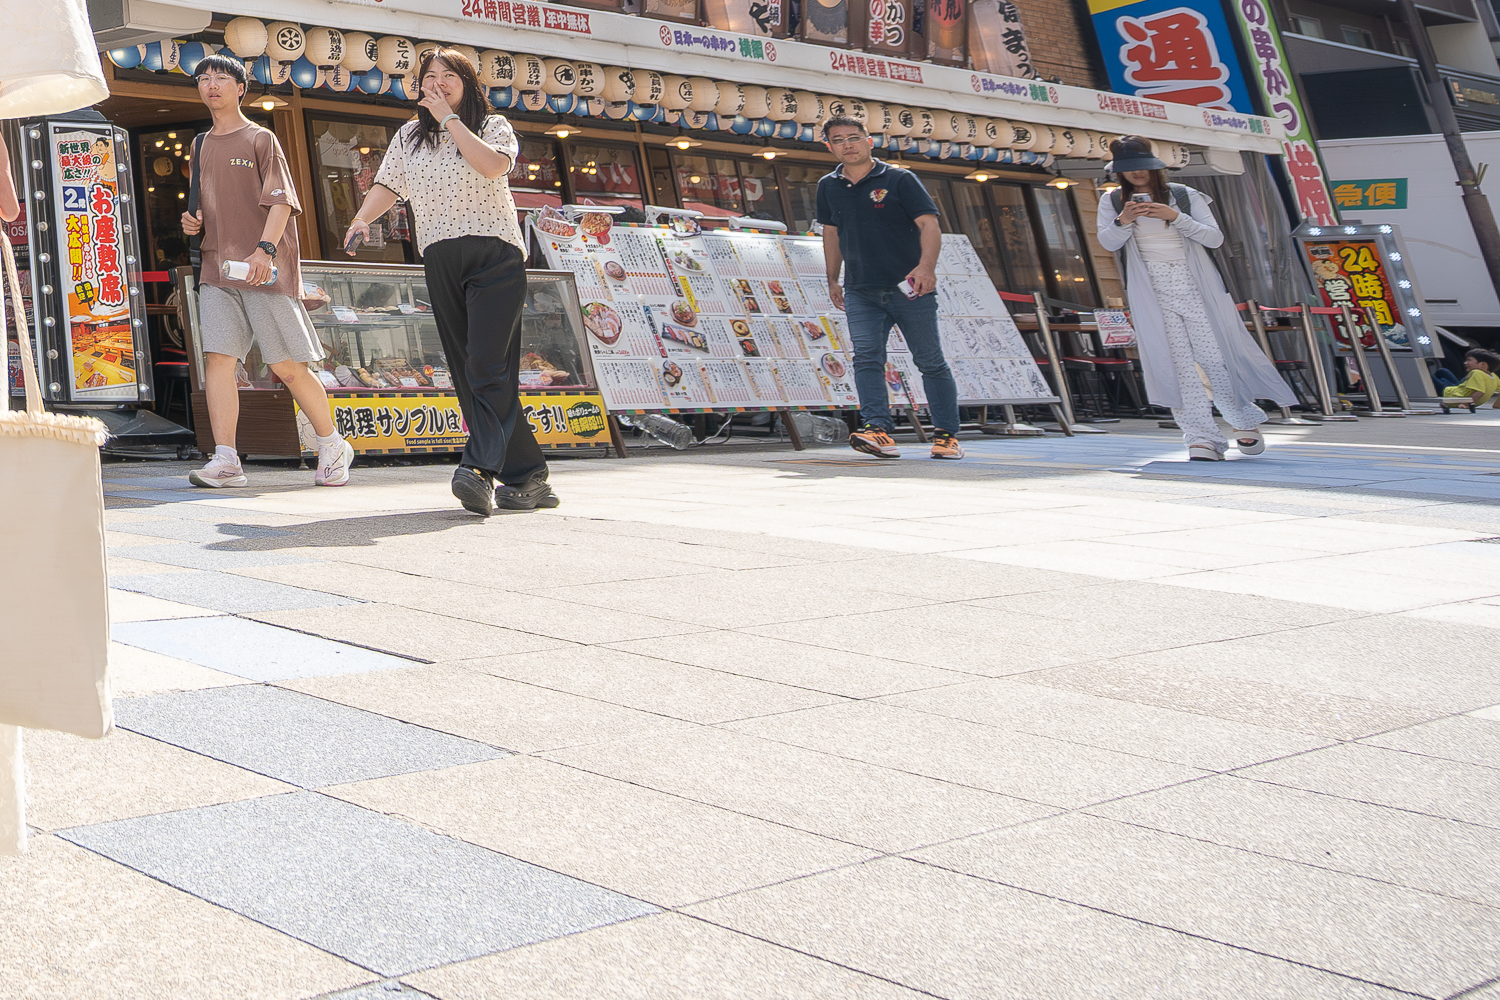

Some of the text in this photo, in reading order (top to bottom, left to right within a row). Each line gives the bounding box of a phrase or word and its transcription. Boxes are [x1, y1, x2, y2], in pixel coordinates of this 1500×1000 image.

[545, 7, 589, 32] 年中無休
[674, 30, 764, 60] 日本一の串かつ 横綱
[830, 51, 888, 80] 24時間営業
[1122, 12, 1237, 112] 通
[59, 142, 91, 154] 新世界
[61, 154, 101, 166] 最大級の
[64, 168, 91, 180] 広さ!!
[1333, 182, 1398, 207] 急便
[66, 214, 83, 282] 大広間!!
[93, 186, 121, 304] お座敷席
[335, 406, 461, 439] 料理サンプルは
